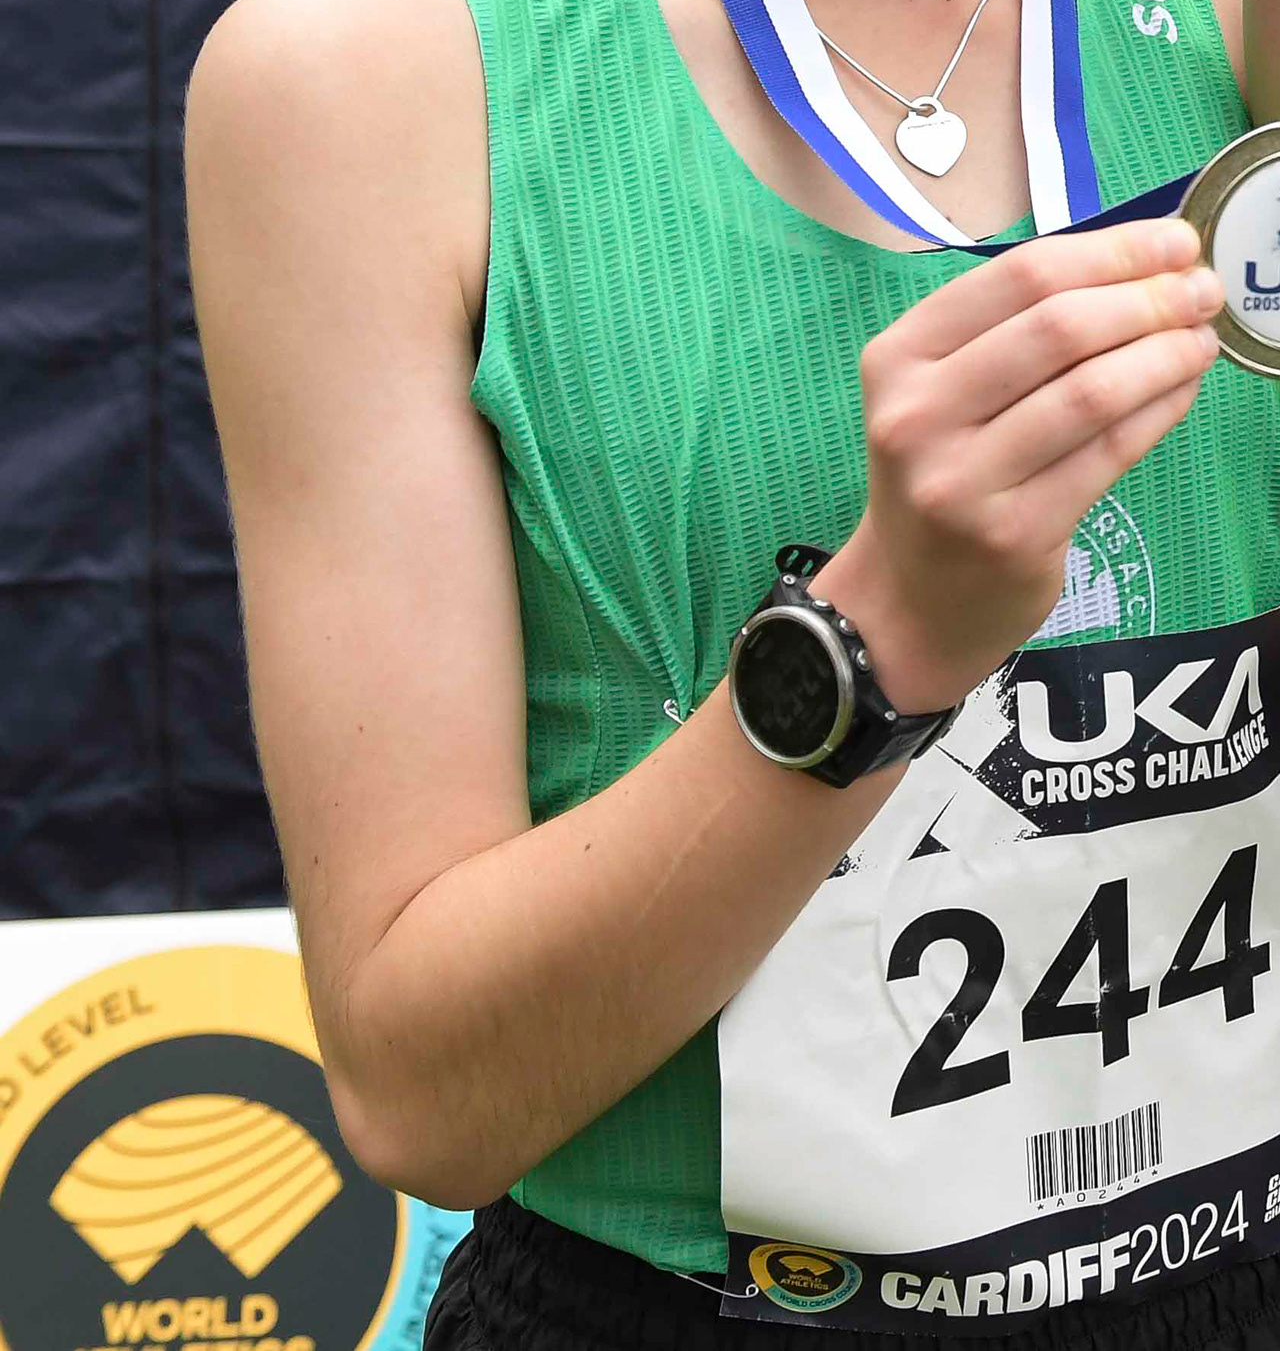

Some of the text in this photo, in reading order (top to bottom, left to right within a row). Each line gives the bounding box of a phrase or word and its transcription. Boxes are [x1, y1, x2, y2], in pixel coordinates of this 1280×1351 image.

[1017, 646, 1263, 763] UKA
[1021, 713, 1270, 807] CROSS CHALLENGE
[886, 843, 1271, 1118] 244
[20, 985, 157, 1077] LEVEL
[101, 1293, 280, 1345] WORLD
